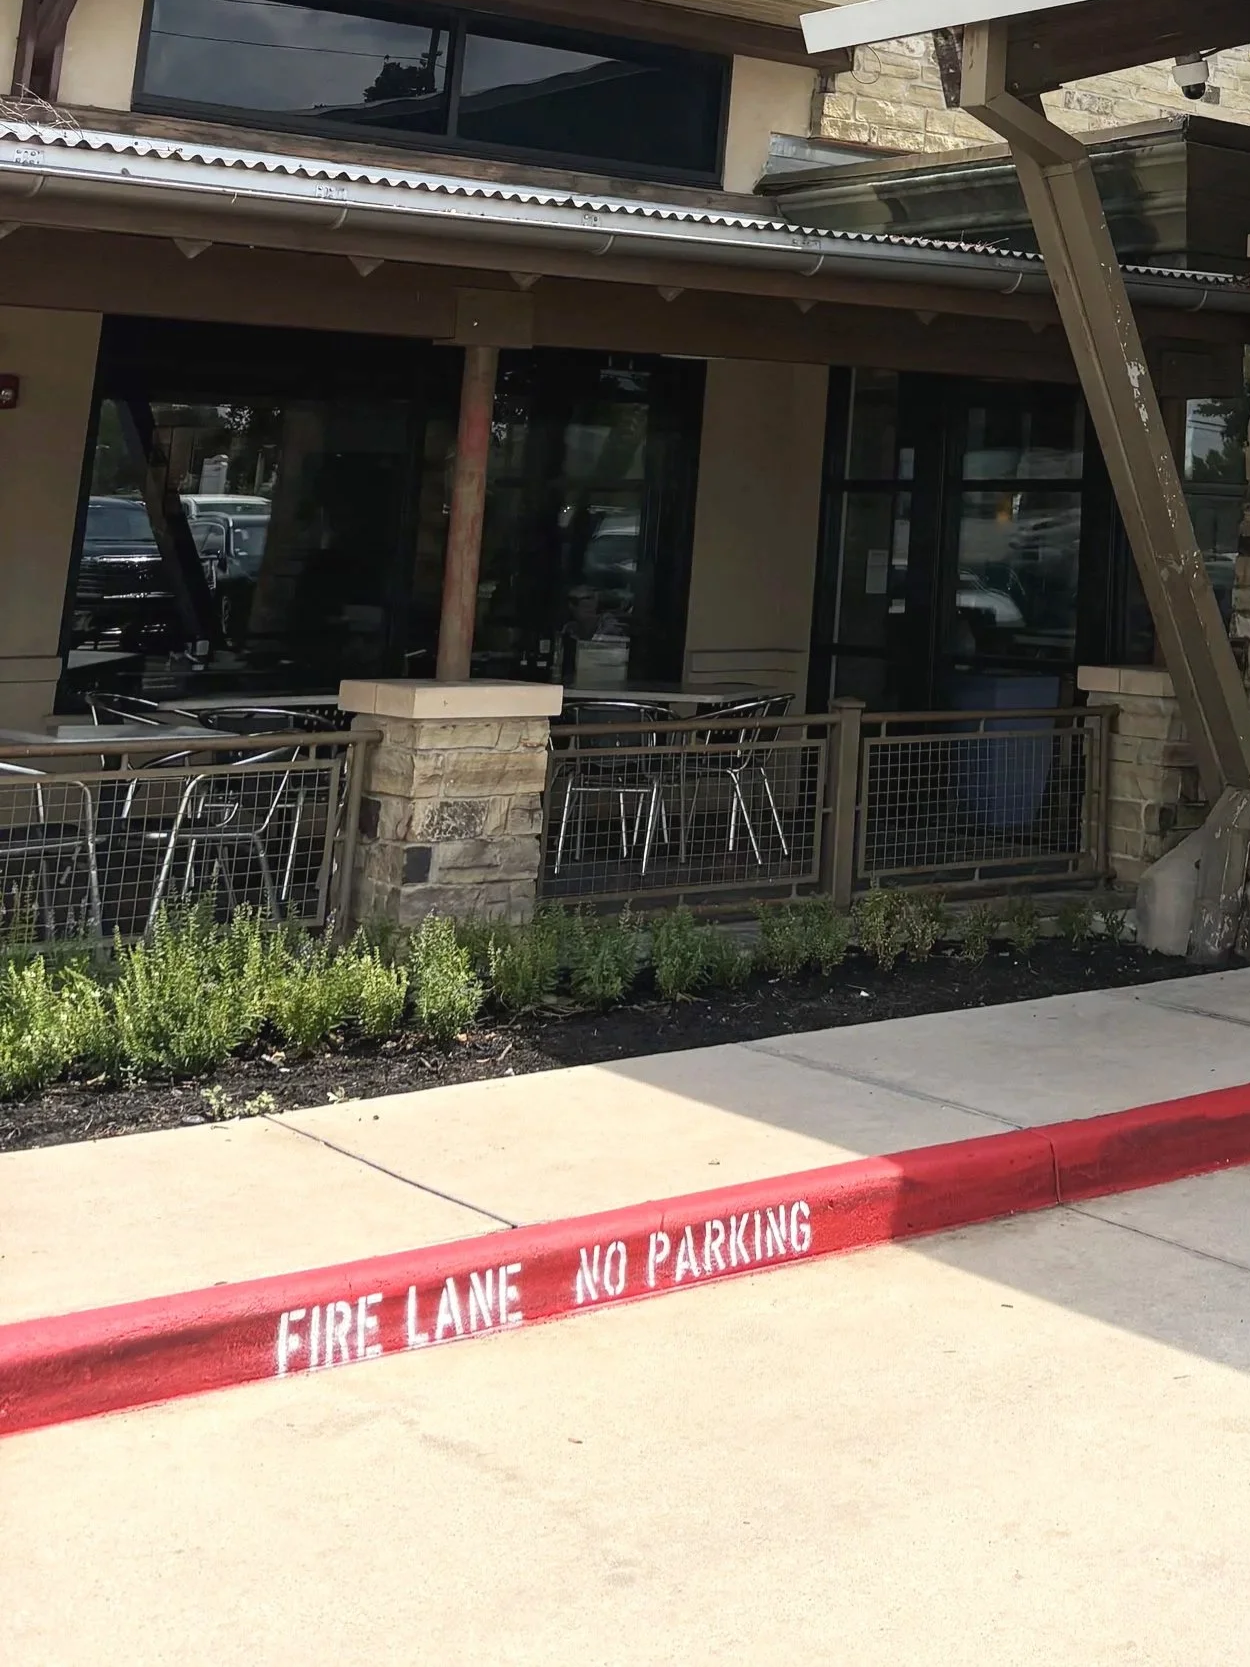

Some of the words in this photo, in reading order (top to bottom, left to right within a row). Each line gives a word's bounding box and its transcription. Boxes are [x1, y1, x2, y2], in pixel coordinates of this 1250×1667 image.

[275, 1292, 383, 1377] FIRE
[407, 1262, 523, 1346] LANE
[575, 1240, 628, 1305] NO
[647, 1199, 811, 1287] PARKING
